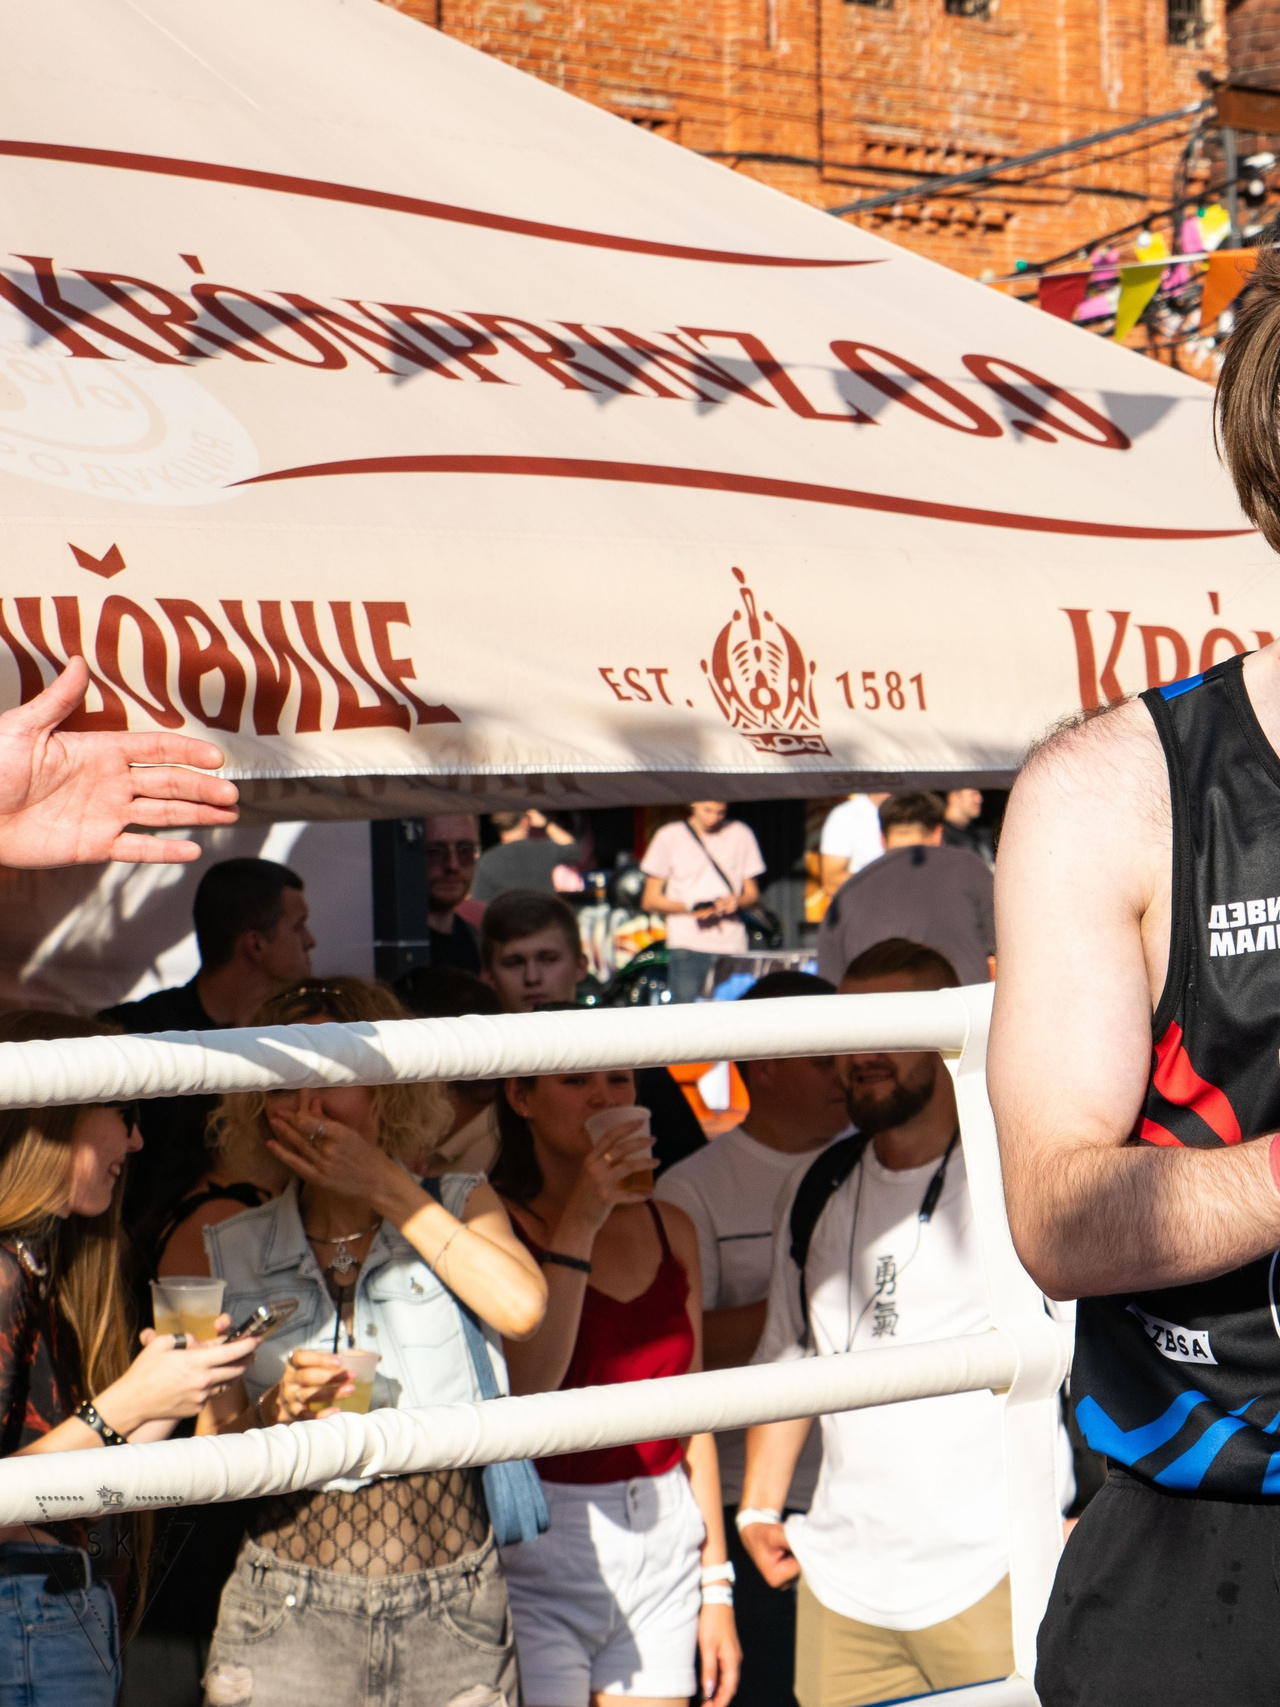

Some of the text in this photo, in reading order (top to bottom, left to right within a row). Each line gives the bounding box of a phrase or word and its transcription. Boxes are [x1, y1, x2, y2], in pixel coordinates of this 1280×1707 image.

[597, 667, 928, 711] EST. 1581
[1136, 1312, 1209, 1359] IBSA
